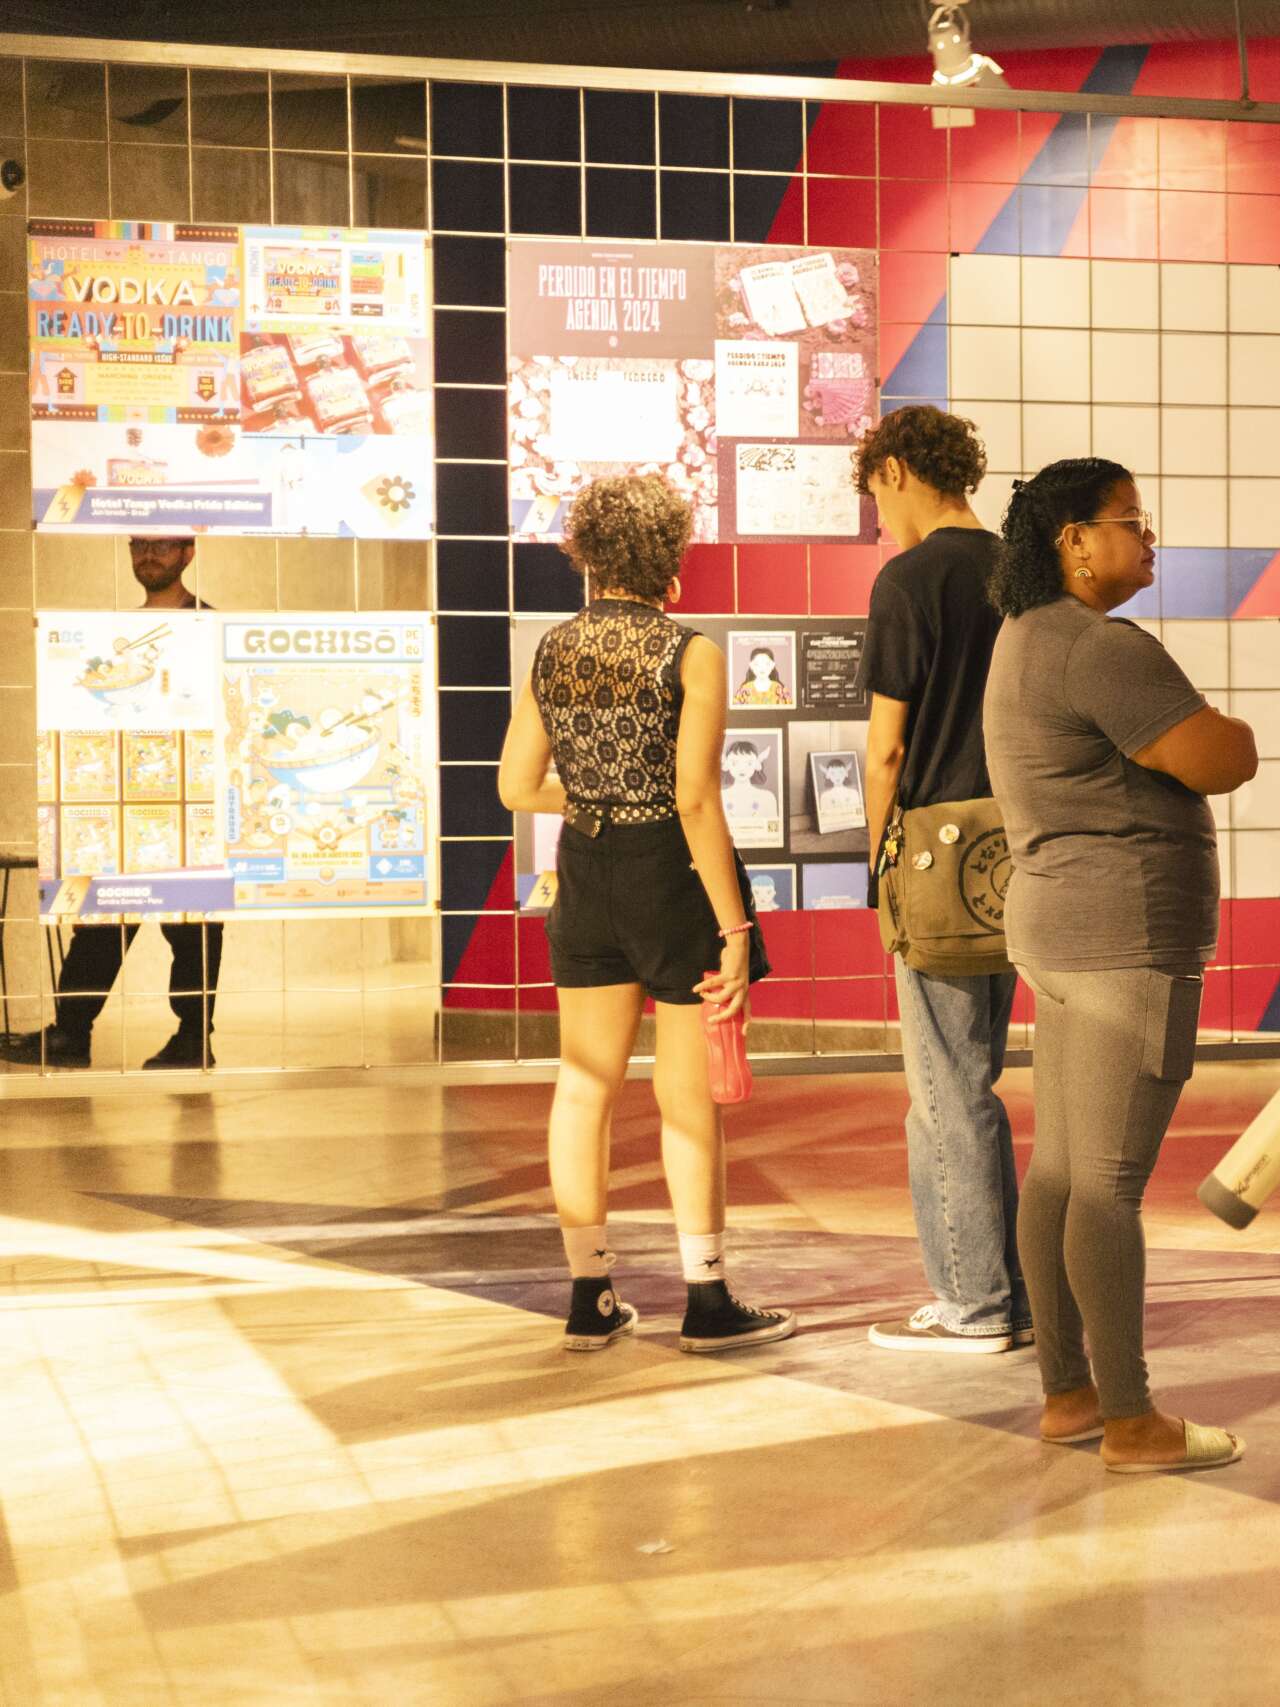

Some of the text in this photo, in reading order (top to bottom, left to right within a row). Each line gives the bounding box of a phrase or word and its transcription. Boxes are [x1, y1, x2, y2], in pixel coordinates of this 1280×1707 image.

[43, 246, 99, 262] HOTEL
[167, 249, 227, 266] TANGO
[68, 276, 198, 305] VODKA
[538, 265, 687, 301] PERDIDO EN EL TIEMPO
[565, 299, 660, 333] AGENDA 2024
[91, 498, 123, 510] Hotel
[243, 629, 397, 655] GOCHISŌ
